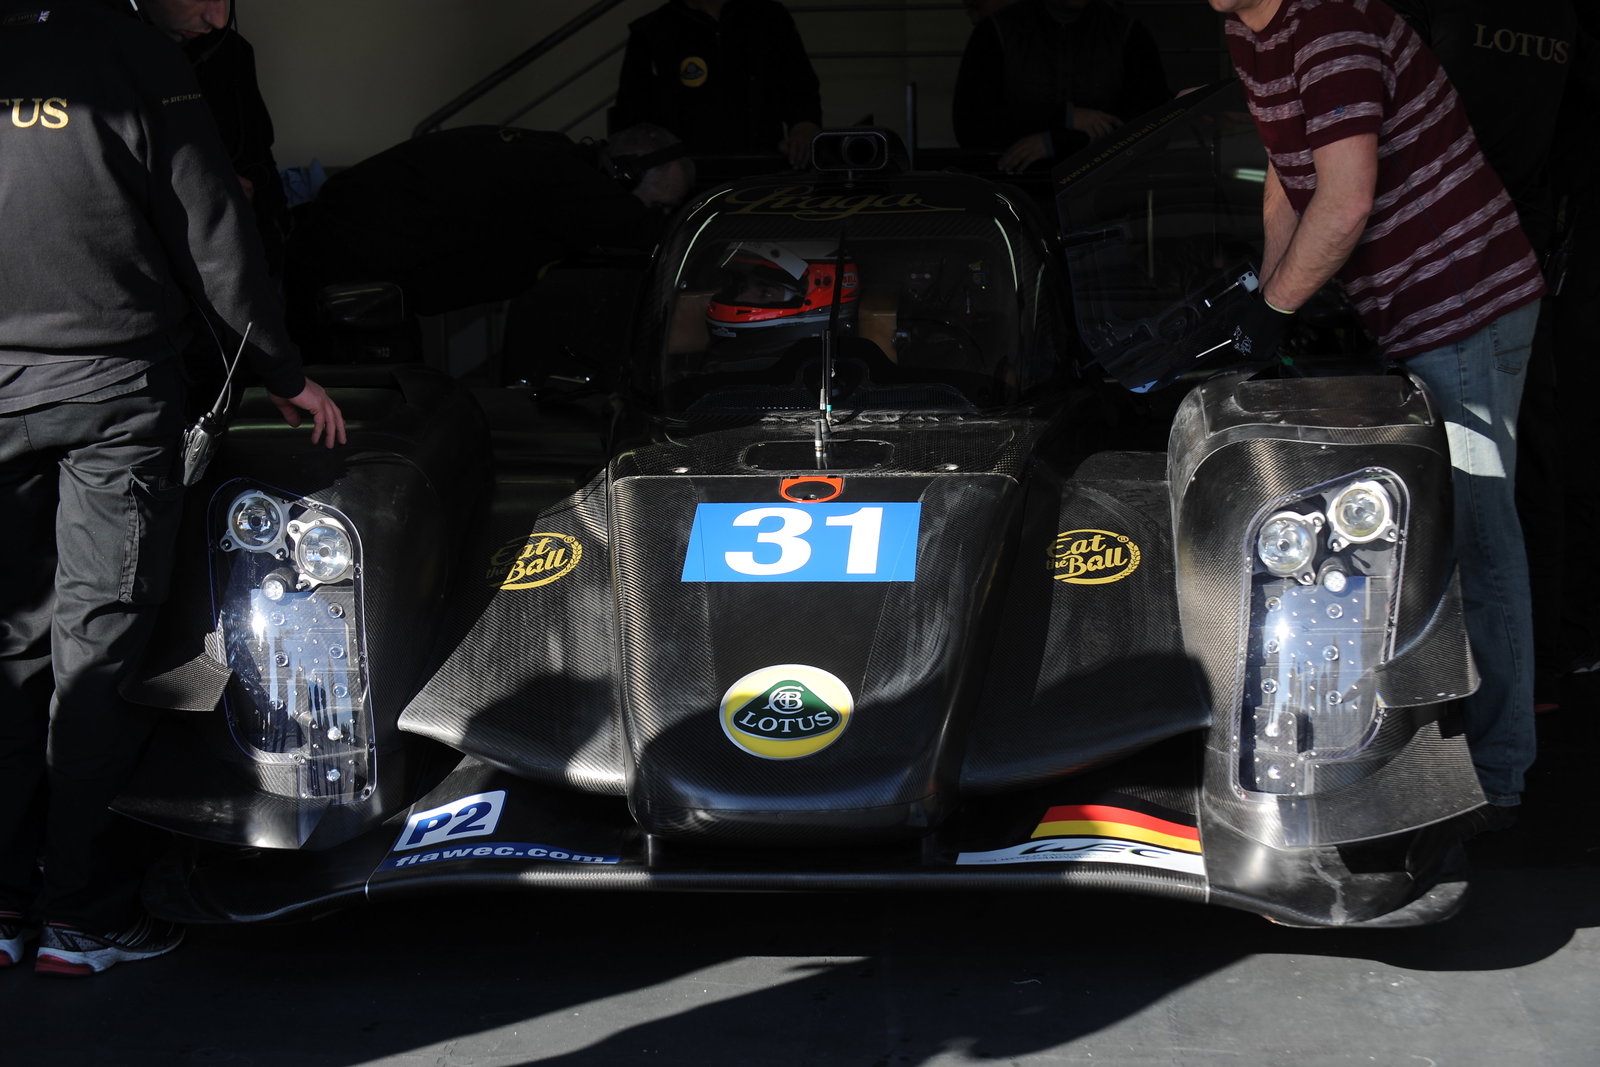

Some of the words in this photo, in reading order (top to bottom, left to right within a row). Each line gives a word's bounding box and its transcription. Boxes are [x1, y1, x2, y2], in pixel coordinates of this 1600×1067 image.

[1472, 23, 1570, 64] LOTUS
[0, 97, 70, 129] US
[724, 506, 884, 576] 31
[1046, 534, 1107, 558] Eat
[502, 548, 568, 585] Ball
[1046, 558, 1069, 571] the
[1053, 547, 1128, 580] Ball
[738, 711, 834, 732] LOTUS
[406, 801, 492, 846] P2
[394, 845, 604, 867] fiawec.com
